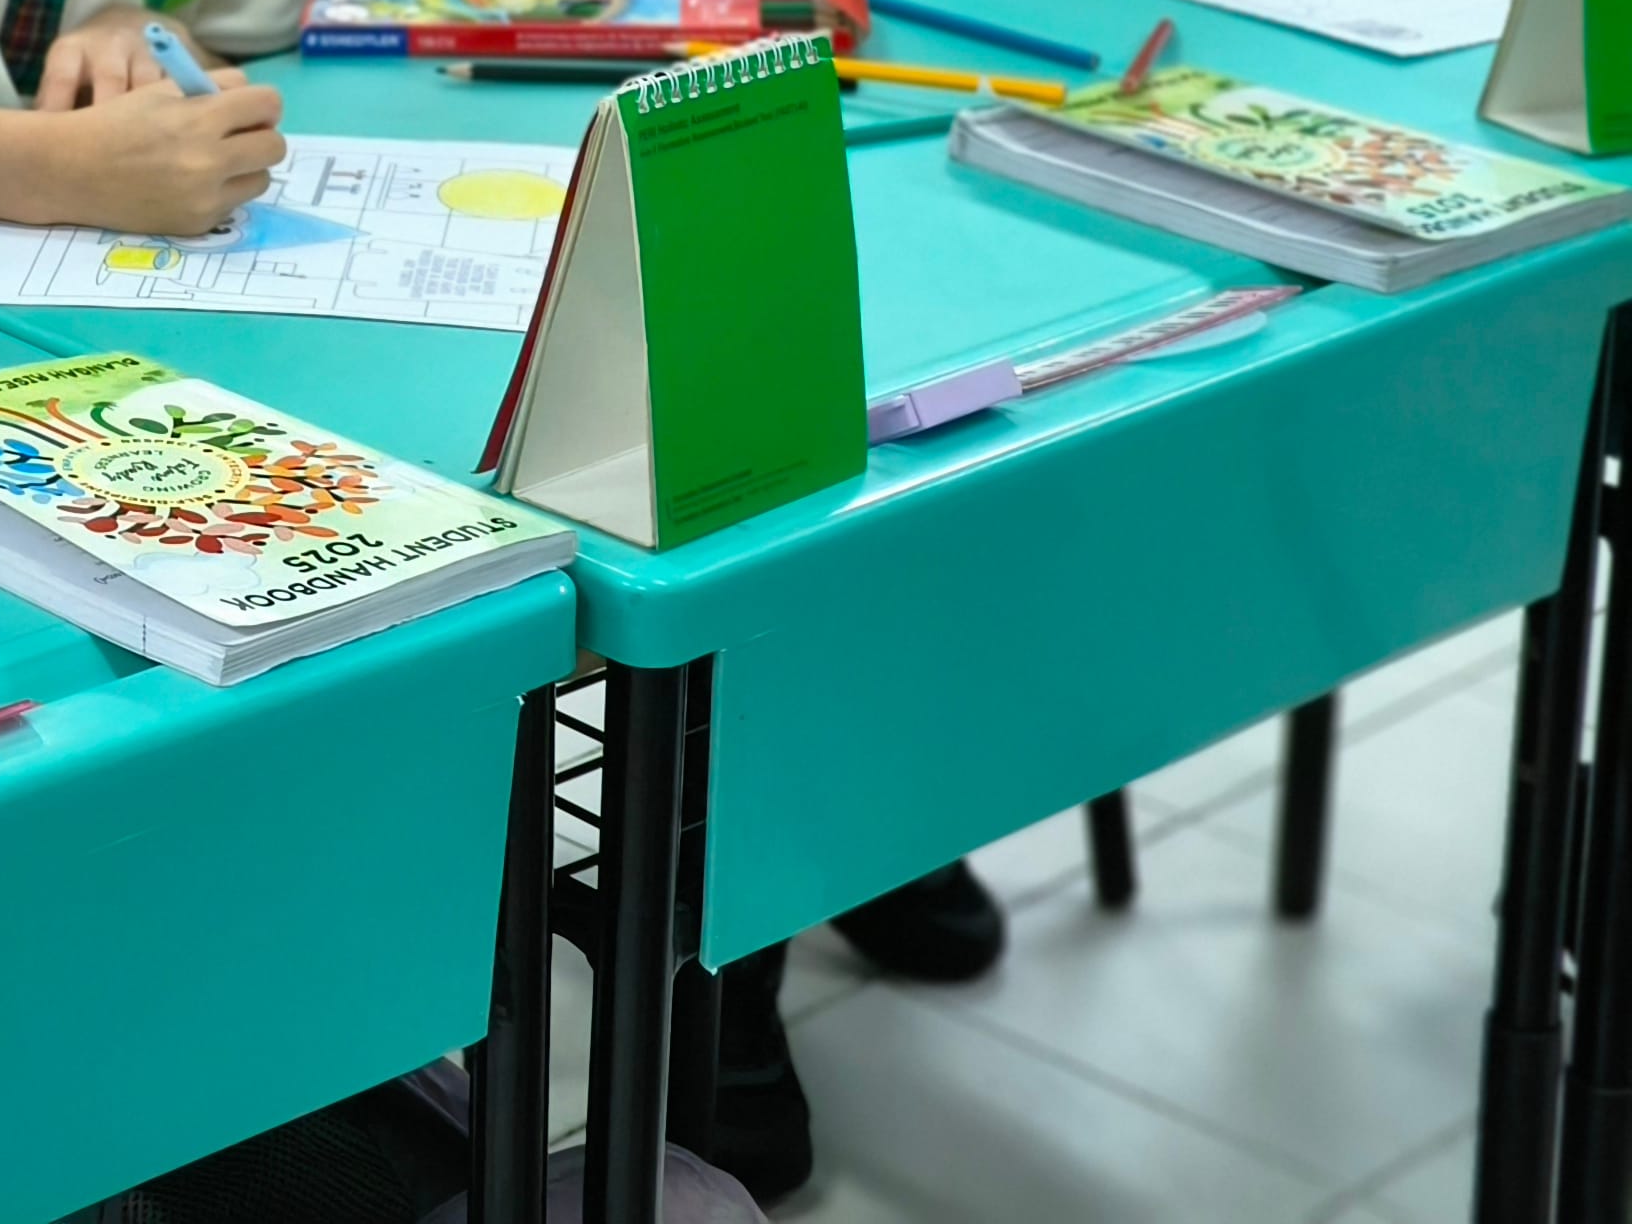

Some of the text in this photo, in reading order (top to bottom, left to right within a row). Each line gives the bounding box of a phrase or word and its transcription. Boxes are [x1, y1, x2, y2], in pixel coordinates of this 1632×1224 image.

[6, 373, 50, 390] RISE
[220, 517, 518, 611] STUDENT HANDBOOK
[283, 533, 384, 573] 2025
